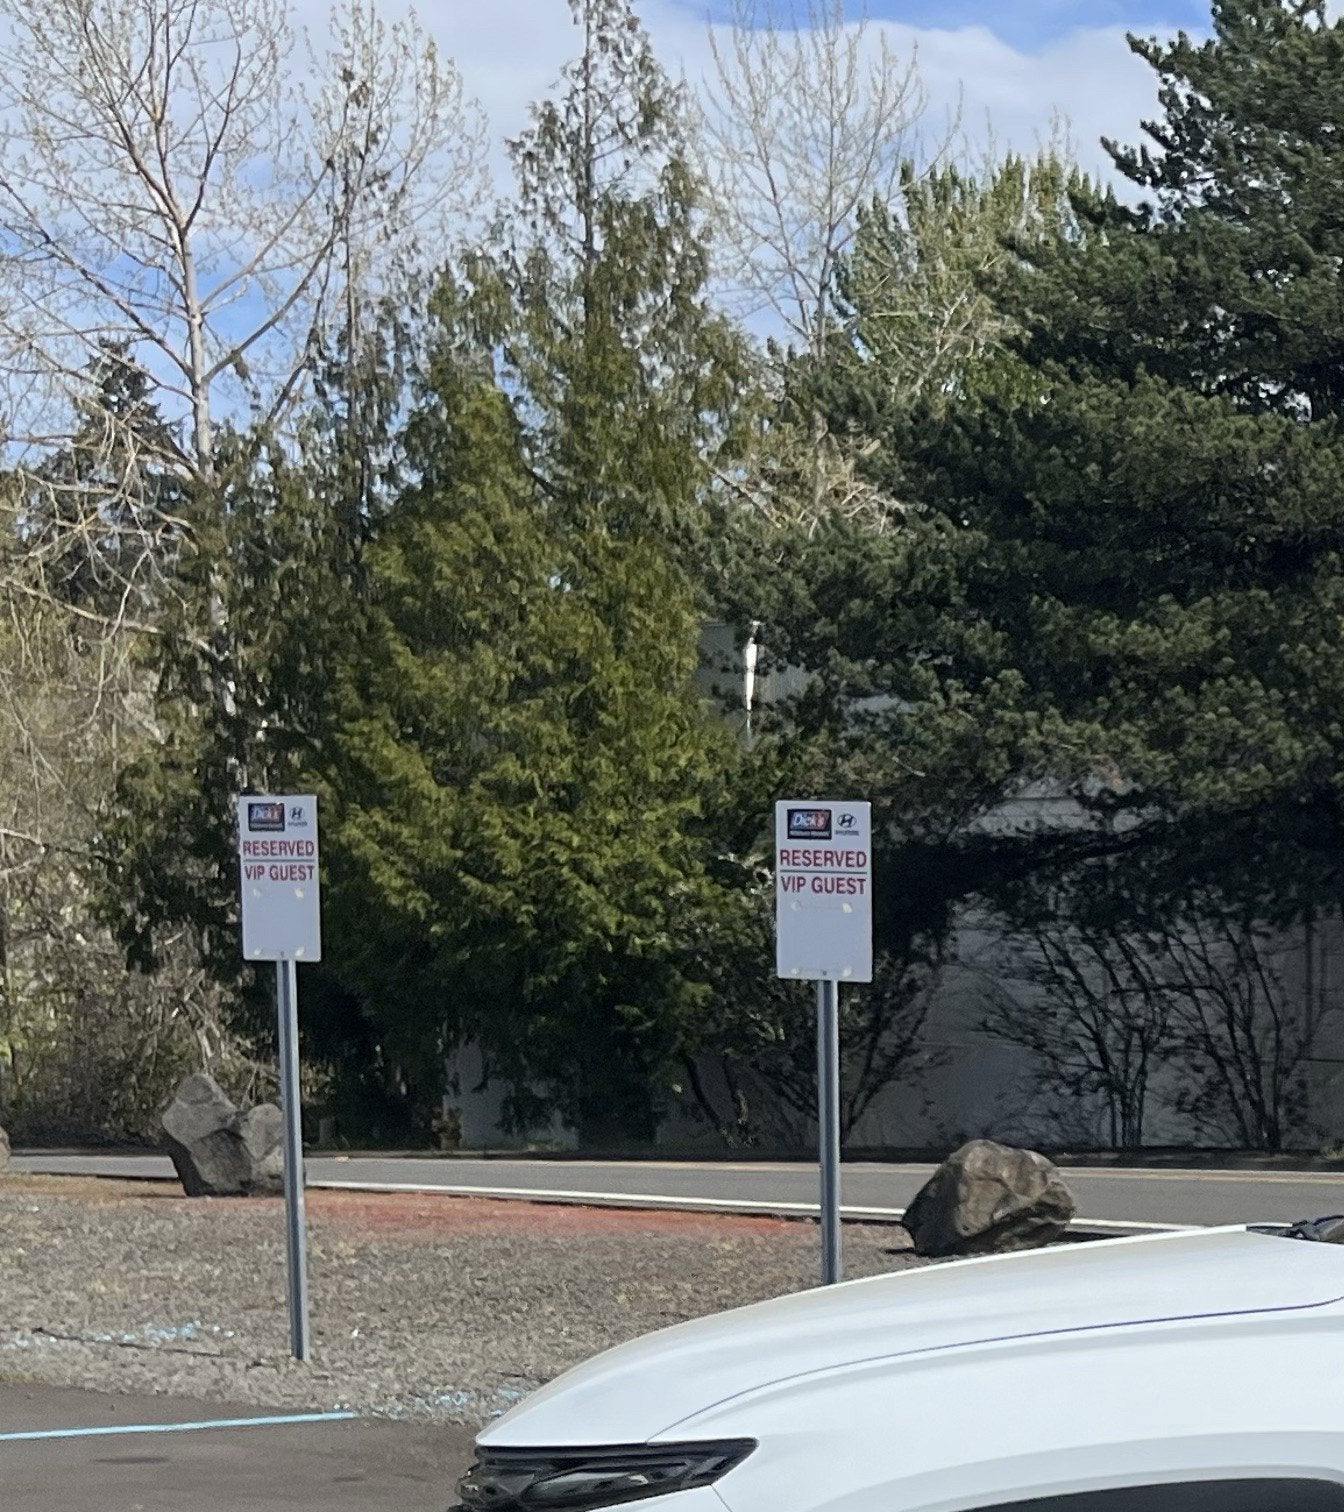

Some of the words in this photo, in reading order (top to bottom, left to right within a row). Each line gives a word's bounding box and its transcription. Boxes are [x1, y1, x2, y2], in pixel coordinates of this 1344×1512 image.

[243, 840, 315, 857] RESERVED
[780, 849, 868, 868] RESERVED
[244, 866, 266, 881] VIP
[269, 865, 316, 881] GUEST
[780, 876, 807, 893] VIP
[811, 877, 867, 894] GUEST
